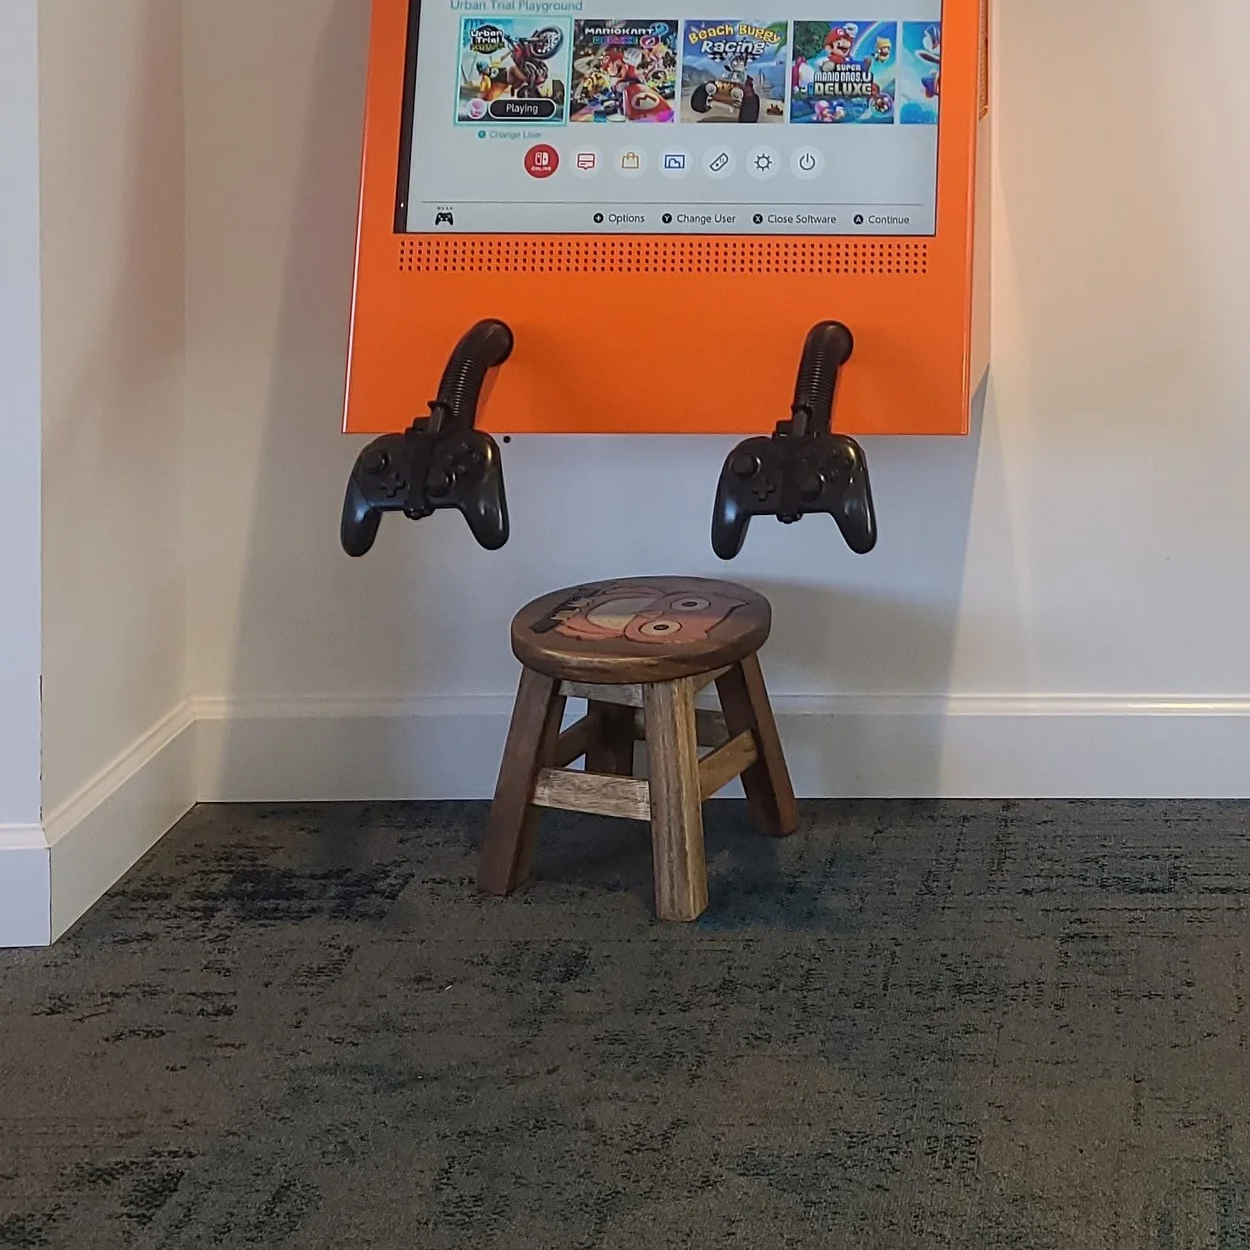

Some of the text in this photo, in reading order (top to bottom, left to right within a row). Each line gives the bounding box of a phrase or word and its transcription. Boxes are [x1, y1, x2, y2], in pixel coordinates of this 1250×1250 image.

[449, 0, 583, 14] Urban Trial Playground
[470, 28, 504, 38] Urban
[688, 22, 781, 45] Beach Buggy
[475, 36, 501, 45] Trial
[700, 40, 766, 55] Racing
[836, 64, 861, 72] SUPER
[814, 82, 872, 96] DELUXE
[505, 103, 539, 115] Playing
[489, 130, 520, 140] Change
[608, 214, 645, 225] Options
[676, 214, 712, 225] Change
[714, 214, 736, 225] User
[767, 214, 794, 224] Close
[795, 214, 837, 224] Software
[868, 215, 910, 225] Continue
